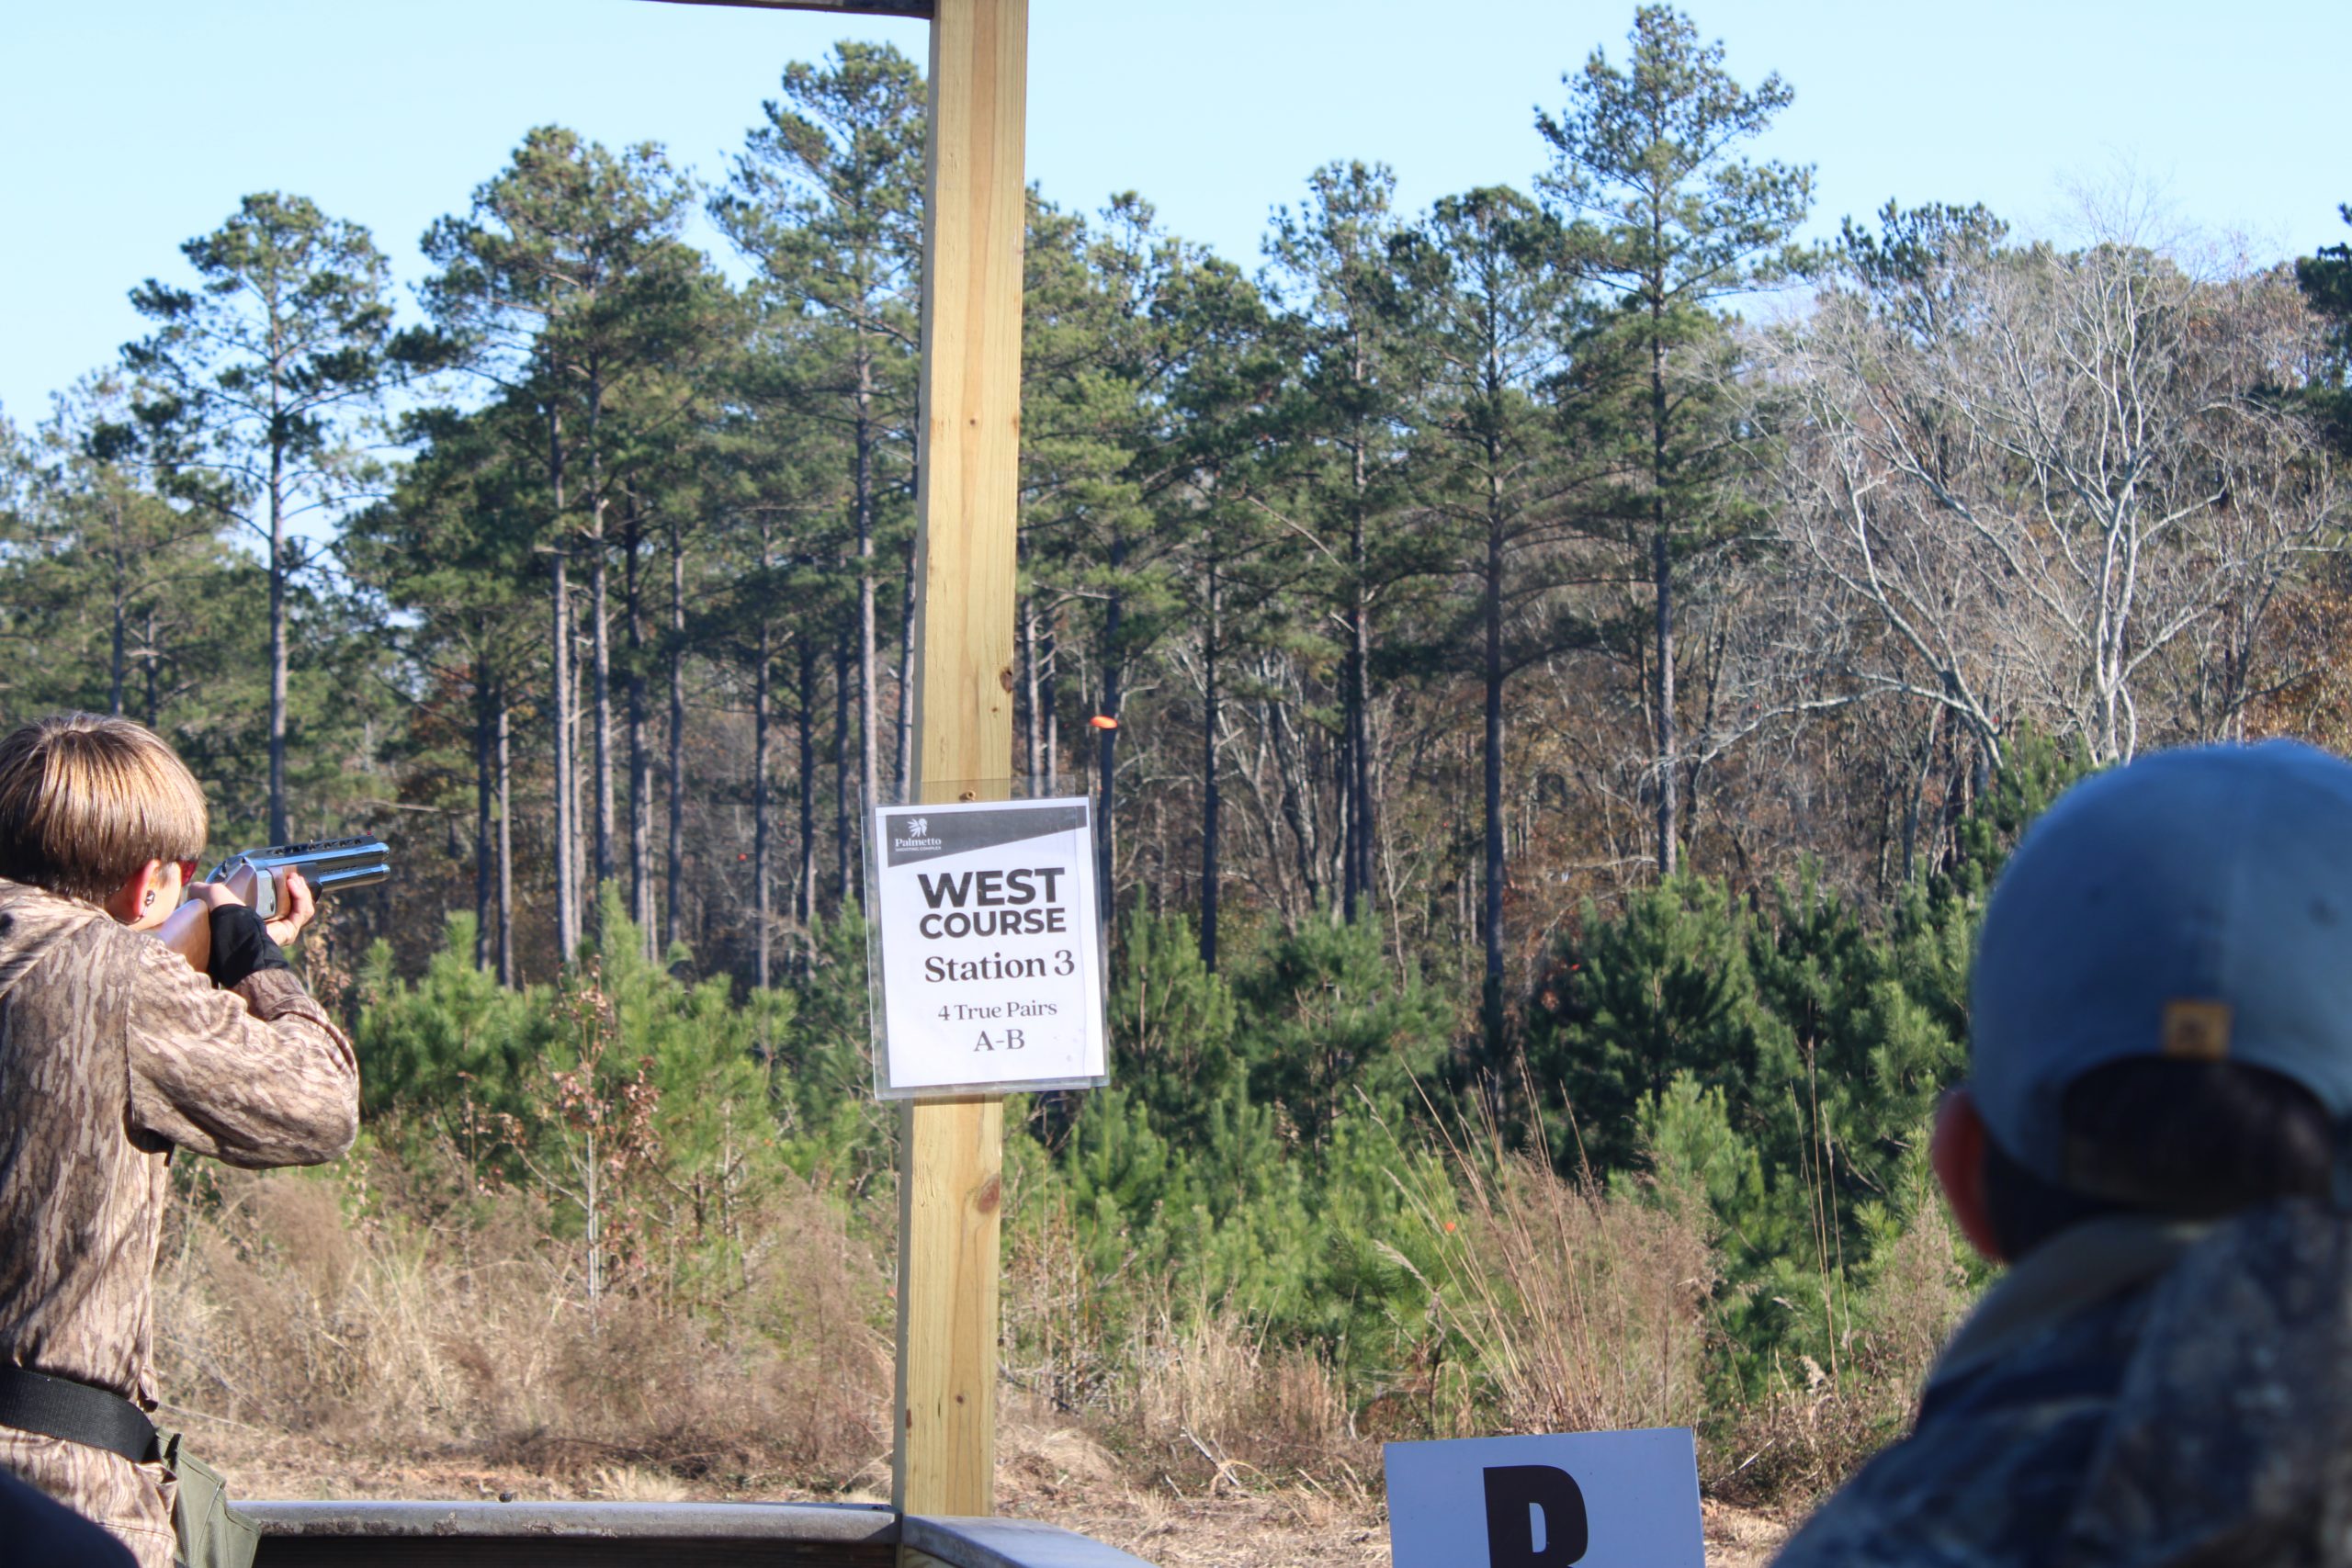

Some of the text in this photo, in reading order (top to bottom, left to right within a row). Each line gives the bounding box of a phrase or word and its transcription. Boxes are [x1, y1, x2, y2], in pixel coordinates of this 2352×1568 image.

[895, 837, 942, 847] Palmetto
[917, 867, 1065, 908] WEST
[920, 908, 1067, 939] COURSE
[924, 950, 1075, 982] Station 3
[938, 1000, 1057, 1021] 4 True Pairs
[974, 1029, 1025, 1051] A-B
